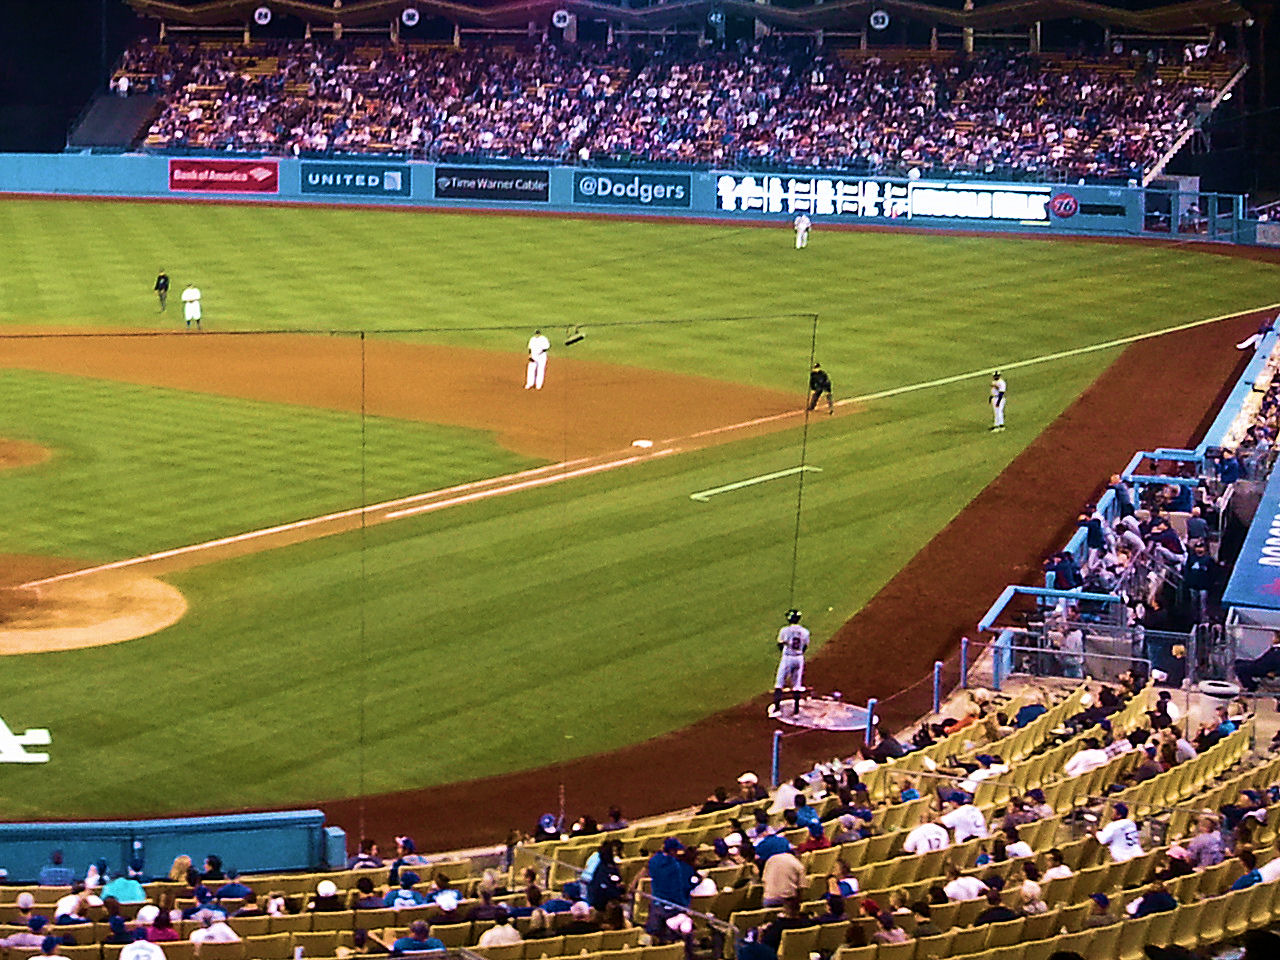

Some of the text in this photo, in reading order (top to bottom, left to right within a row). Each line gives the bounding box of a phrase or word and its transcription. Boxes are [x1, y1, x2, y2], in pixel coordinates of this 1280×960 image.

[174, 169, 248, 182] Bank of America
[308, 173, 380, 187] UNITED
[452, 177, 476, 189] Time
[477, 178, 514, 190] Warner
[579, 176, 685, 202] @Dodgers
